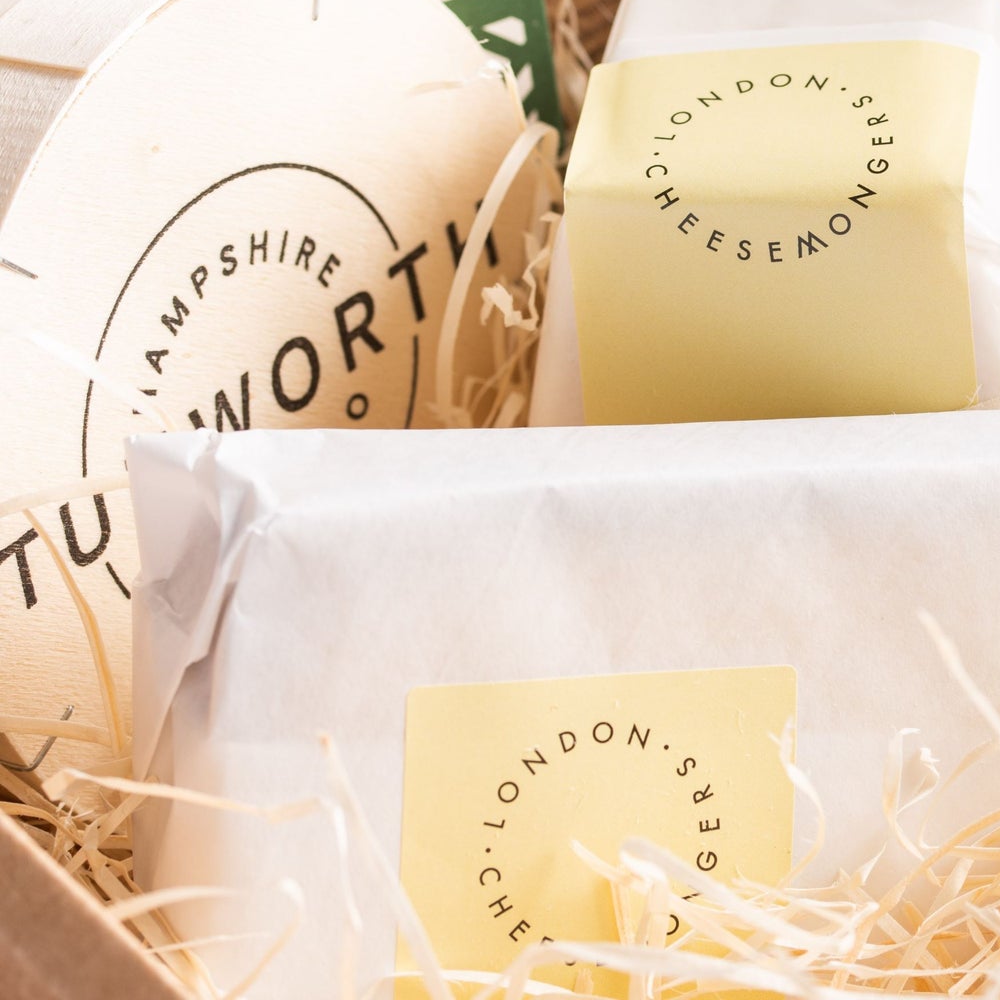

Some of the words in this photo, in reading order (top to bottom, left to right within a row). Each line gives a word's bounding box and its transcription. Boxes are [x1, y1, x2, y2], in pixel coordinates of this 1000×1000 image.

[654, 73, 830, 142] LONDON
[645, 94, 895, 264] CHEESEMONGERS
[0, 197, 499, 611] TUWORTH
[483, 721, 651, 830] LONDON
